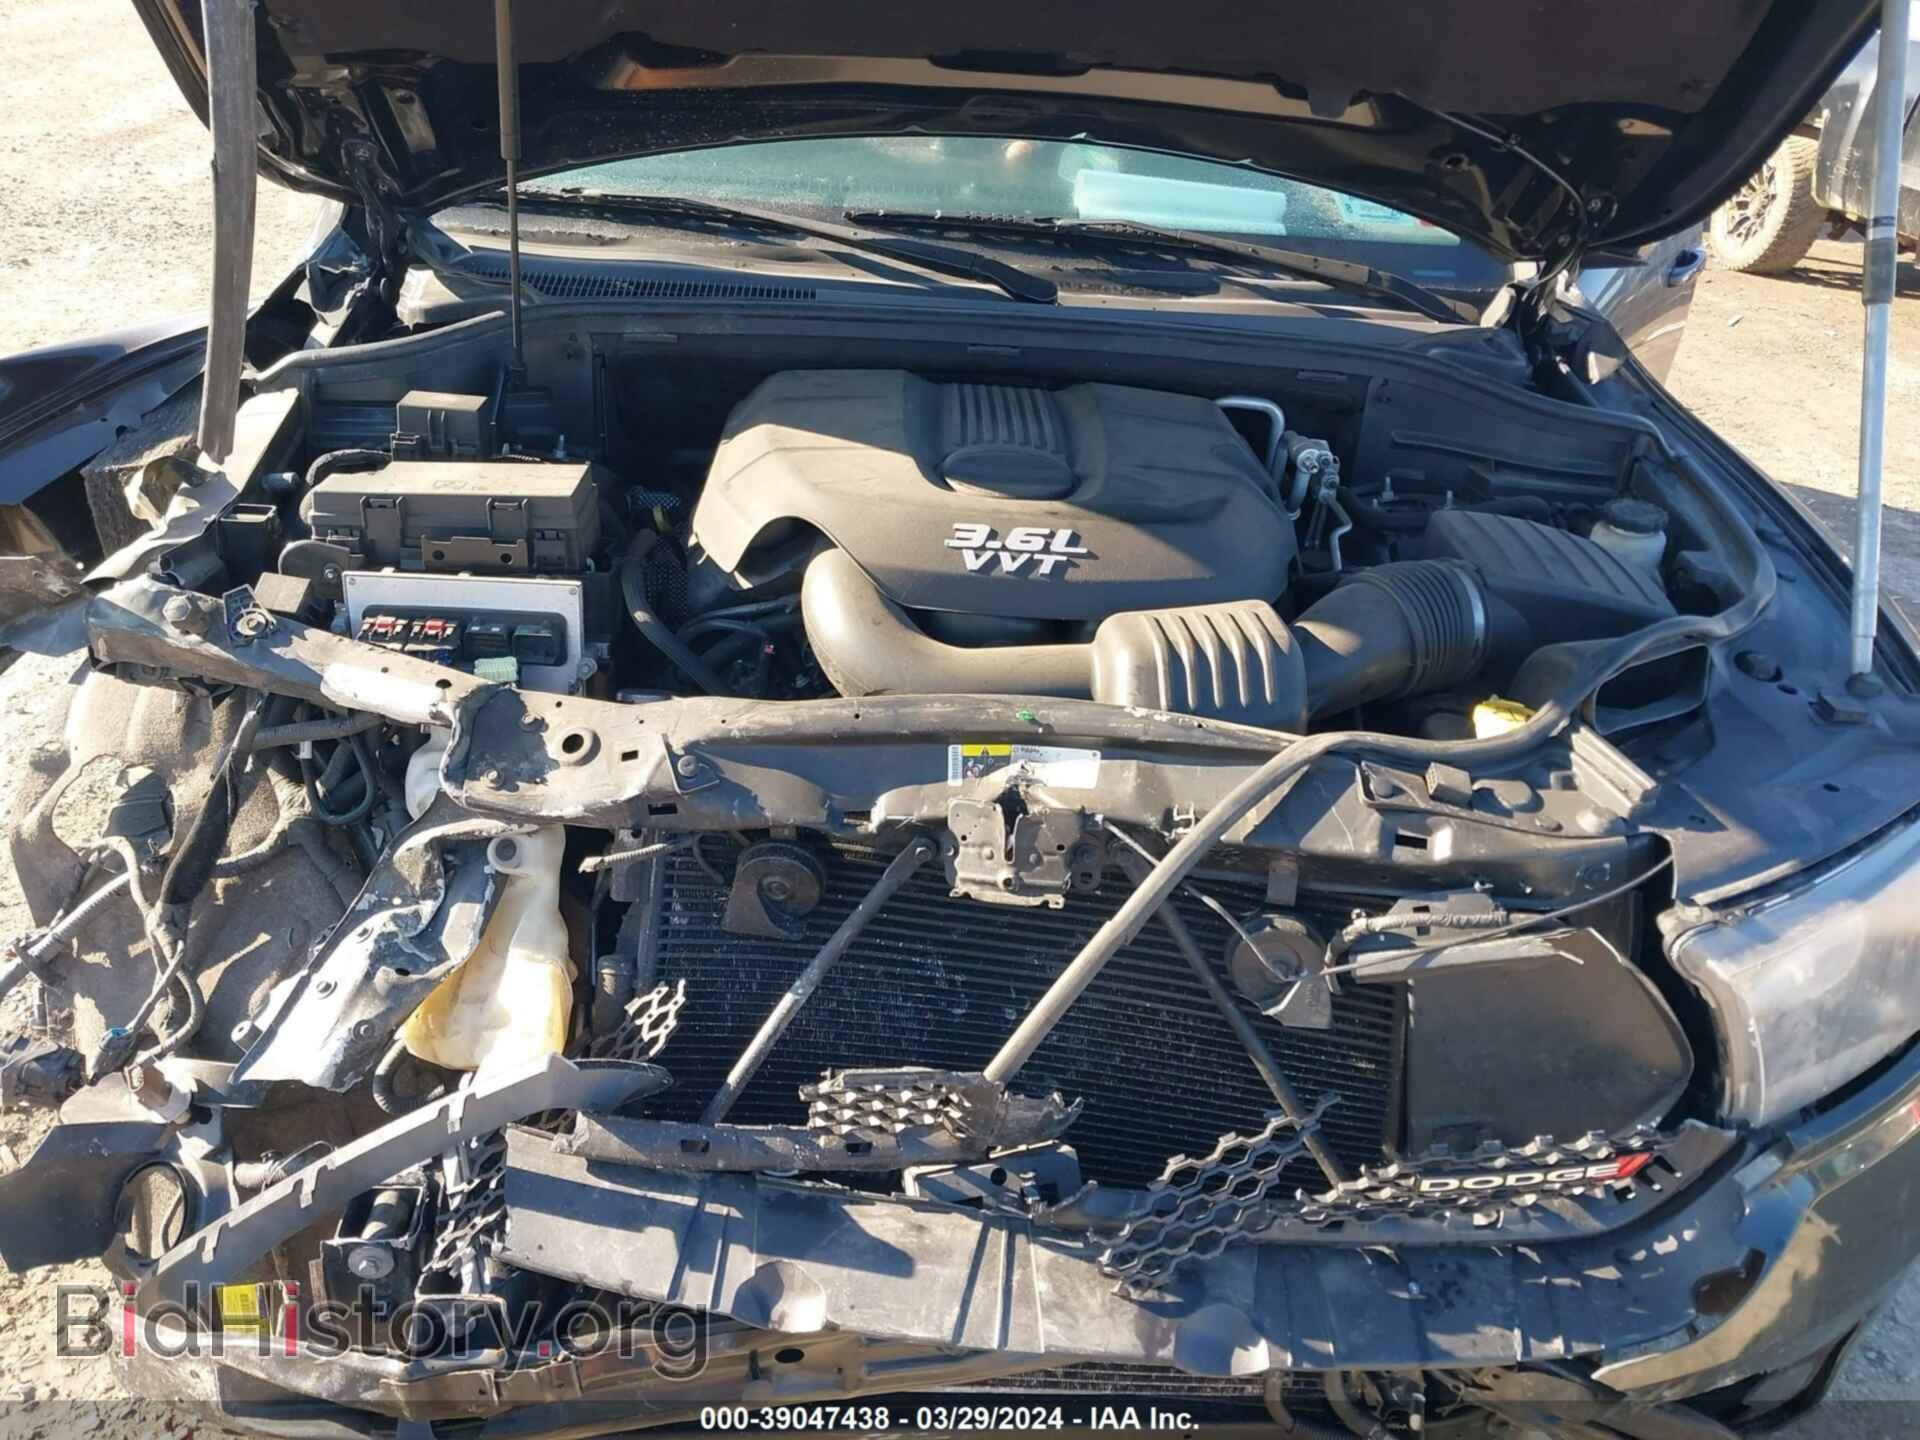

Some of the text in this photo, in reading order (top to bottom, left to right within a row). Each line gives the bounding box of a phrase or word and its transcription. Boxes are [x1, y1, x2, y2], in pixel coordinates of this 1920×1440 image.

[944, 523, 1088, 553] 3.6L
[962, 549, 1067, 574] VVT
[1418, 1162, 1620, 1192] DODGE
